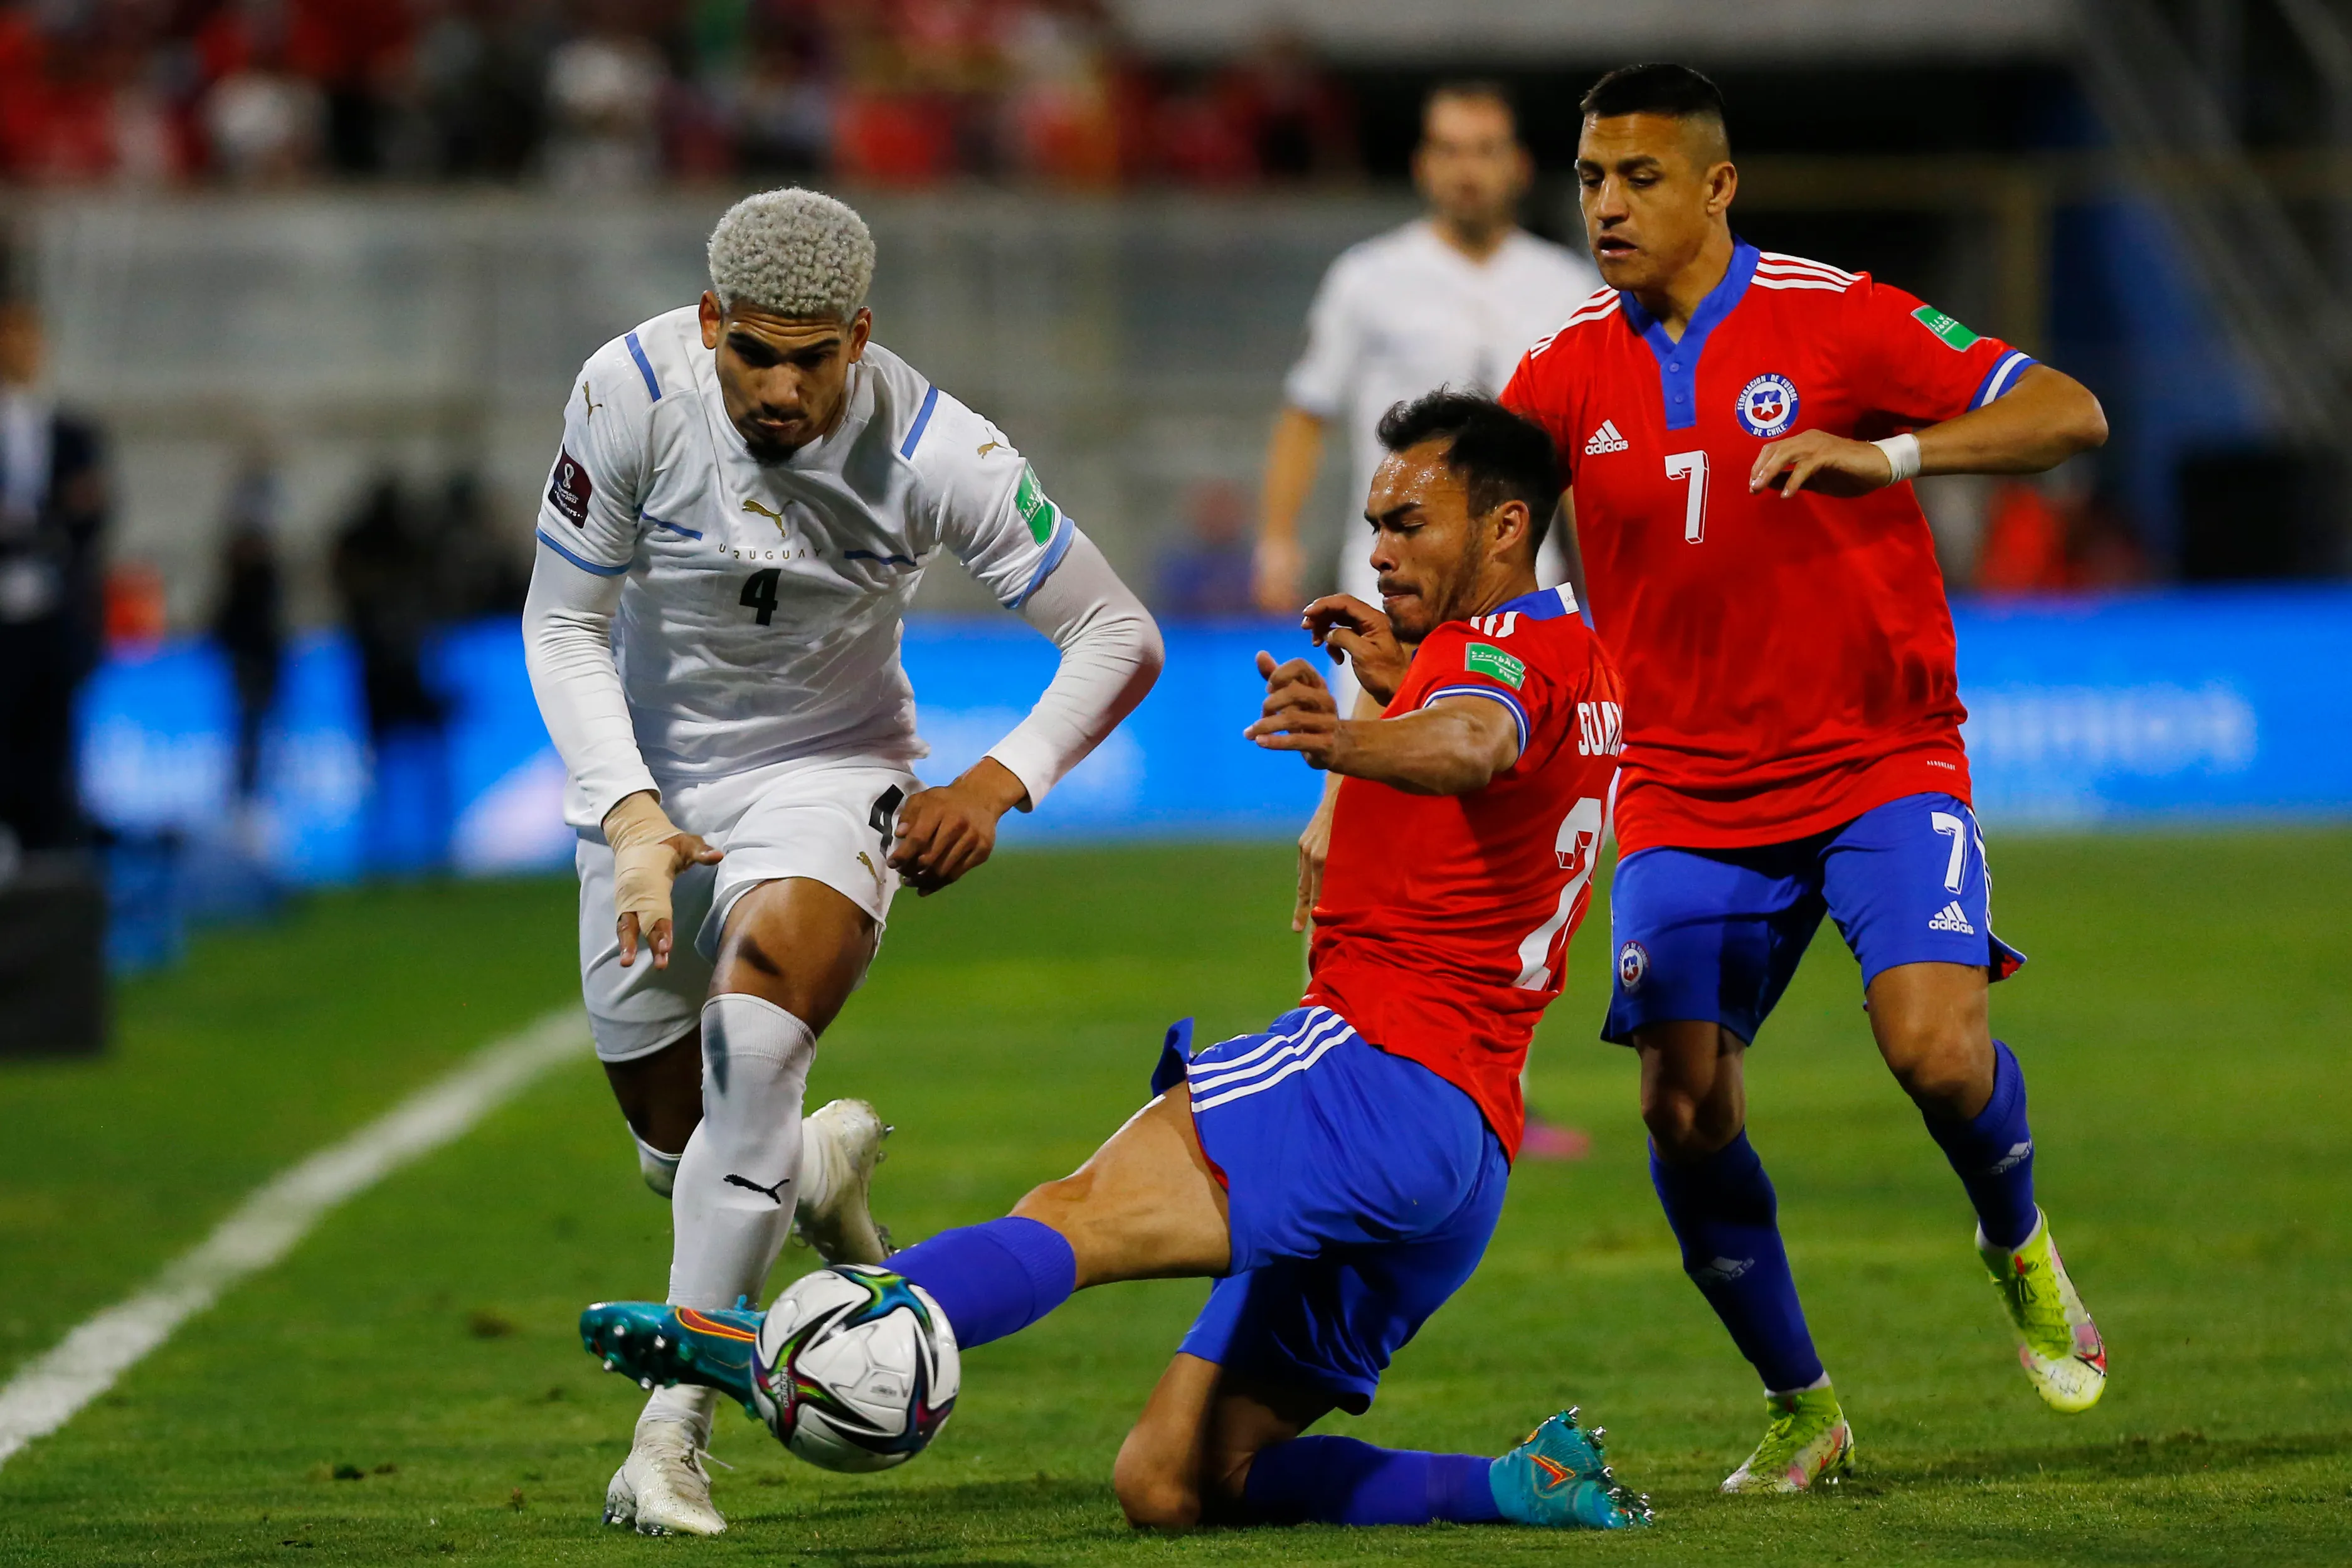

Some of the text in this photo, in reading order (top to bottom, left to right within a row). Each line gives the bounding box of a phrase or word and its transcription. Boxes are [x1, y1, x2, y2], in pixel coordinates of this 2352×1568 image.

[1737, 375, 1766, 410] FEDERACION
[1781, 378, 1798, 403] FUTBOL
[1585, 440, 1629, 455] adidas
[1753, 423, 1786, 437] DE CHILE
[1664, 450, 1710, 544] 7
[719, 543, 822, 559] URUGUAY
[739, 568, 782, 627] 4
[1577, 701, 1623, 757] SUAZ
[868, 783, 905, 860] 4
[1931, 812, 1968, 895] 7
[1511, 797, 1602, 992] 2
[1928, 917, 1974, 935] adidas
